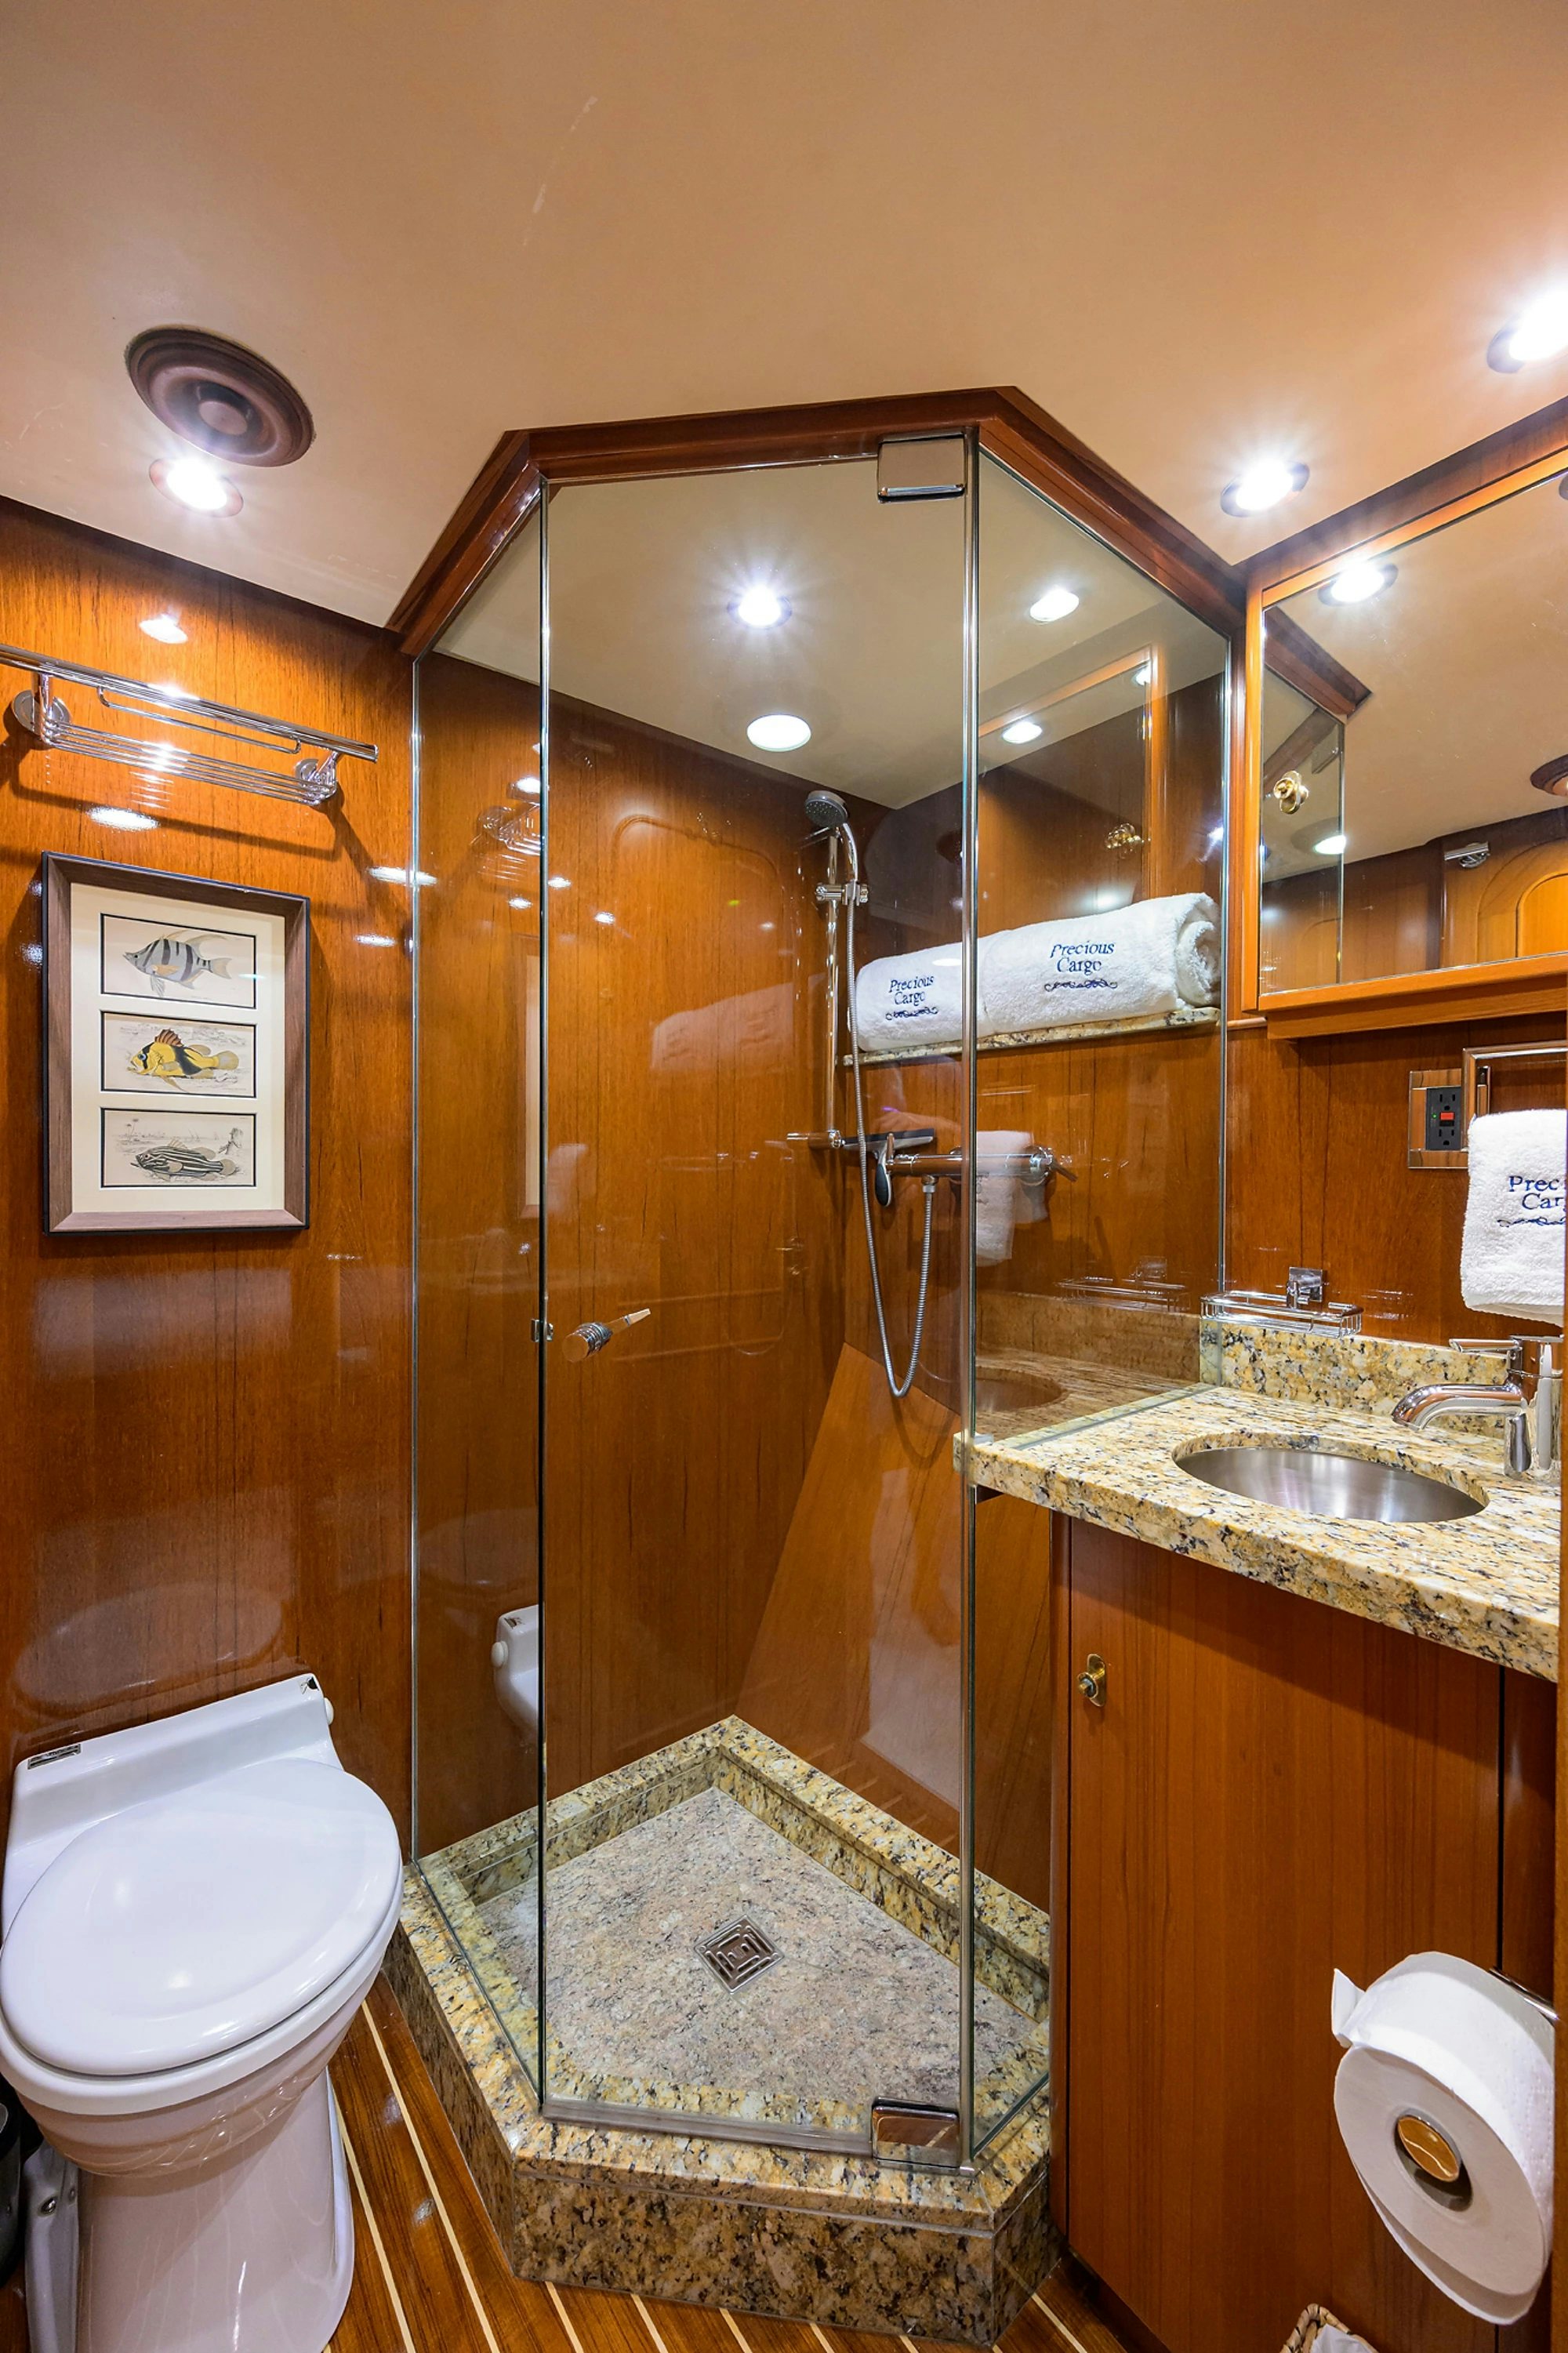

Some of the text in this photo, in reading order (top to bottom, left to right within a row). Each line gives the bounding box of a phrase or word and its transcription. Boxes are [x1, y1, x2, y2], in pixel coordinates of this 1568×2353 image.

[1049, 940, 1115, 958] Precious
[1057, 957, 1102, 975] Cargo
[888, 975, 935, 993] Precious
[895, 991, 925, 1006] Cargo
[1509, 1175, 1566, 1192] Prec
[1522, 1193, 1566, 1210] Car
